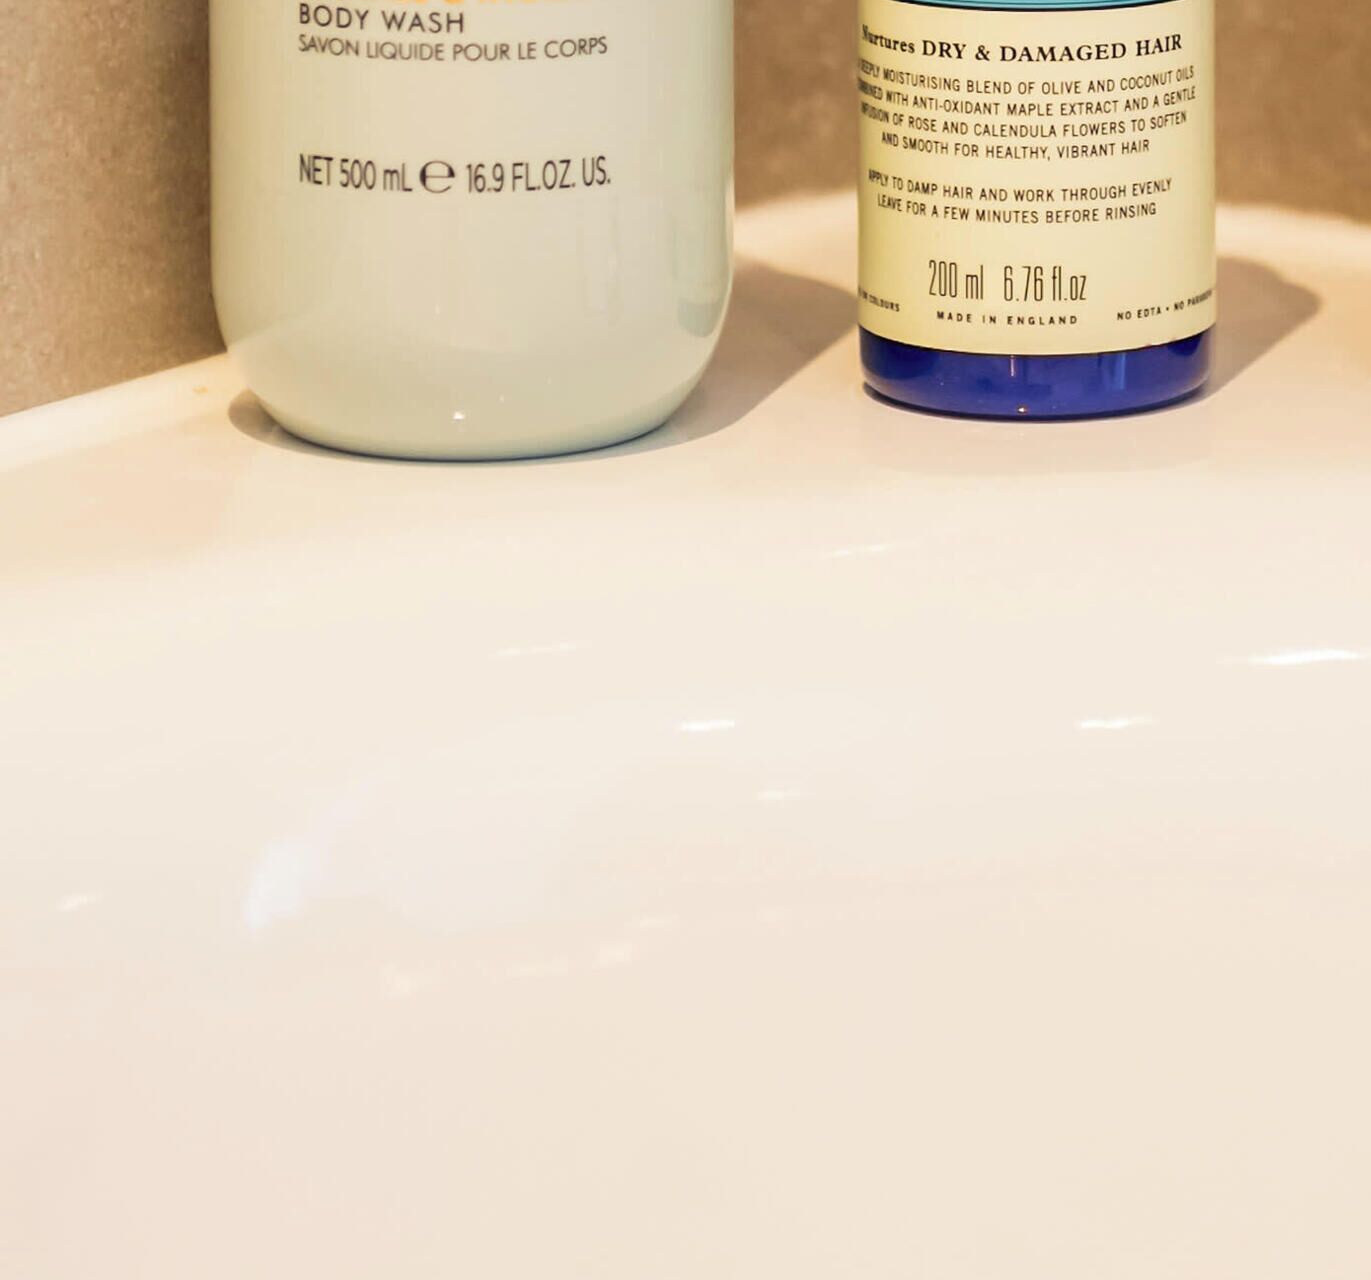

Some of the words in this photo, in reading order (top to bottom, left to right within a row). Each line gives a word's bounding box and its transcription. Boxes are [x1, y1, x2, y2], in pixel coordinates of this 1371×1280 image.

[300, 4, 369, 31] BODY
[382, 11, 465, 33] WASH
[299, 35, 359, 56] SAVON
[367, 42, 445, 61] LIQUIDE
[453, 43, 510, 62] POUR
[519, 42, 536, 60] LE
[545, 36, 608, 59] CORPS
[862, 24, 915, 54] Nurtures
[922, 40, 966, 59] DRY
[975, 45, 990, 61] &
[1000, 43, 1126, 62] DAMAGED
[1136, 34, 1182, 57] HAIR
[883, 68, 960, 91] MOISTURISING
[966, 80, 1012, 95] BLEND
[1018, 81, 1034, 94] OF
[1041, 80, 1081, 94] OLIVE
[1088, 76, 1115, 91] AND
[1120, 70, 1172, 91] COCONUT
[1176, 65, 1194, 81] OILS
[886, 87, 908, 107] WITH
[913, 94, 999, 115] ANTI-OXIDANT
[1007, 103, 1053, 116] MAPLE
[1060, 101, 1118, 116] EXTRACT
[1124, 97, 1148, 111] AND
[1153, 95, 1159, 108] A
[1164, 86, 1196, 105] GENTLE
[908, 117, 936, 132] ROSE
[942, 120, 968, 135] AND
[974, 124, 1056, 138] CALENDULA
[1063, 121, 1125, 136] FLOWERS
[1131, 118, 1145, 132] TO
[1150, 110, 1187, 129] SOFTEN
[882, 131, 898, 147] AND
[903, 135, 948, 155] SMOOTH
[954, 142, 979, 157] FOR
[986, 145, 1050, 161] HEALTHY,
[1057, 143, 1115, 159] VIBRANT
[1122, 140, 1150, 154] HAIR
[300, 154, 333, 186] NET
[340, 159, 376, 191] 500
[383, 161, 412, 192] mL
[467, 163, 504, 193] 16.9
[868, 168, 889, 187] APPLY
[892, 176, 904, 190] TO
[907, 179, 938, 195] DAMP
[943, 184, 972, 199] HAIR
[979, 188, 1007, 202] AND
[1014, 189, 1055, 202] WORK
[1061, 184, 1126, 201] THROUGH
[1132, 178, 1172, 196] EVENLY
[878, 194, 901, 212] LEAVE
[906, 200, 927, 216] FOR
[931, 205, 938, 218] A
[944, 206, 968, 221] FEW
[976, 209, 1039, 224] MINUTES
[1046, 208, 1098, 224] BEFORE
[1105, 202, 1156, 220] RINSING
[928, 259, 957, 298] 200
[965, 265, 984, 300] ml
[1004, 265, 1043, 301] 6.76
[1052, 266, 1087, 301] fl.oz
[937, 310, 972, 323] MADE
[982, 314, 996, 324] IN
[1007, 315, 1077, 325] ENGLAND
[1117, 311, 1131, 320] NO
